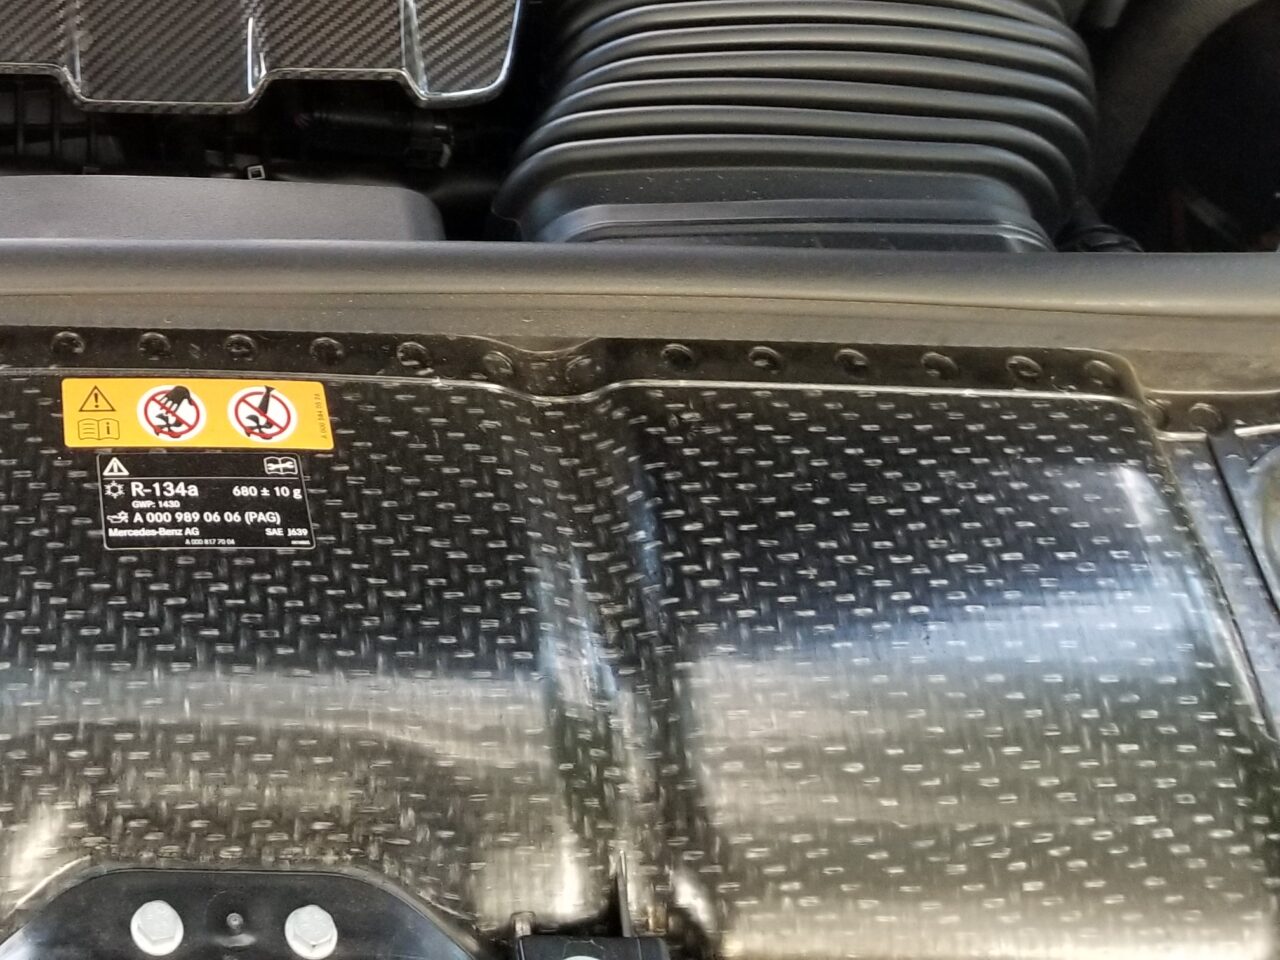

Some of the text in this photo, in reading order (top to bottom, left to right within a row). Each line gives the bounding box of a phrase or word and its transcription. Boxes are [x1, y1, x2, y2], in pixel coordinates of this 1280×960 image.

[130, 481, 199, 497] R-134a
[232, 485, 258, 497] 680
[273, 486, 290, 497] 10
[292, 488, 303, 500] g
[131, 500, 181, 509] GWP: 1430
[133, 511, 281, 525] A 000 989 06 06 (PAG)
[108, 527, 200, 537] Mercedes-Benz AG
[264, 527, 309, 537] SAE J639
